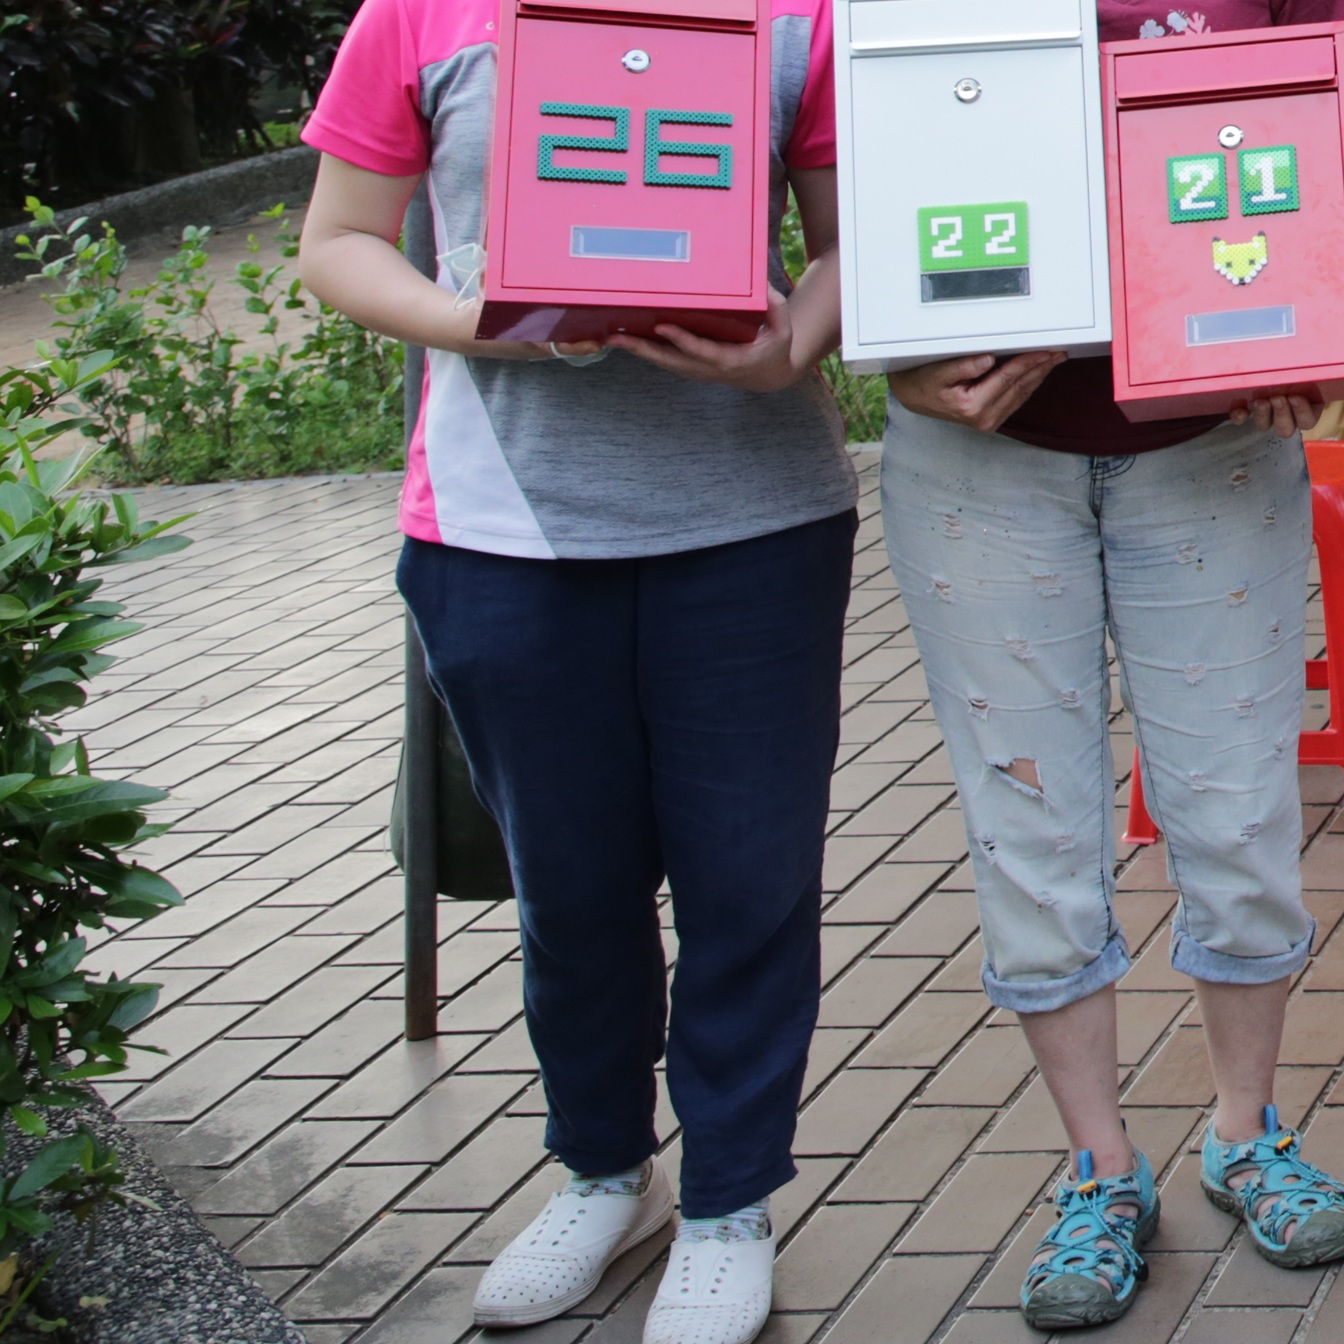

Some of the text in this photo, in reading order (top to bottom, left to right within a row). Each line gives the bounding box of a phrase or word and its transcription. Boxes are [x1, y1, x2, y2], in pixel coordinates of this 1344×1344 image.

[537, 101, 734, 190] 26
[1178, 155, 1287, 211] 21
[930, 212, 1017, 258] 22
